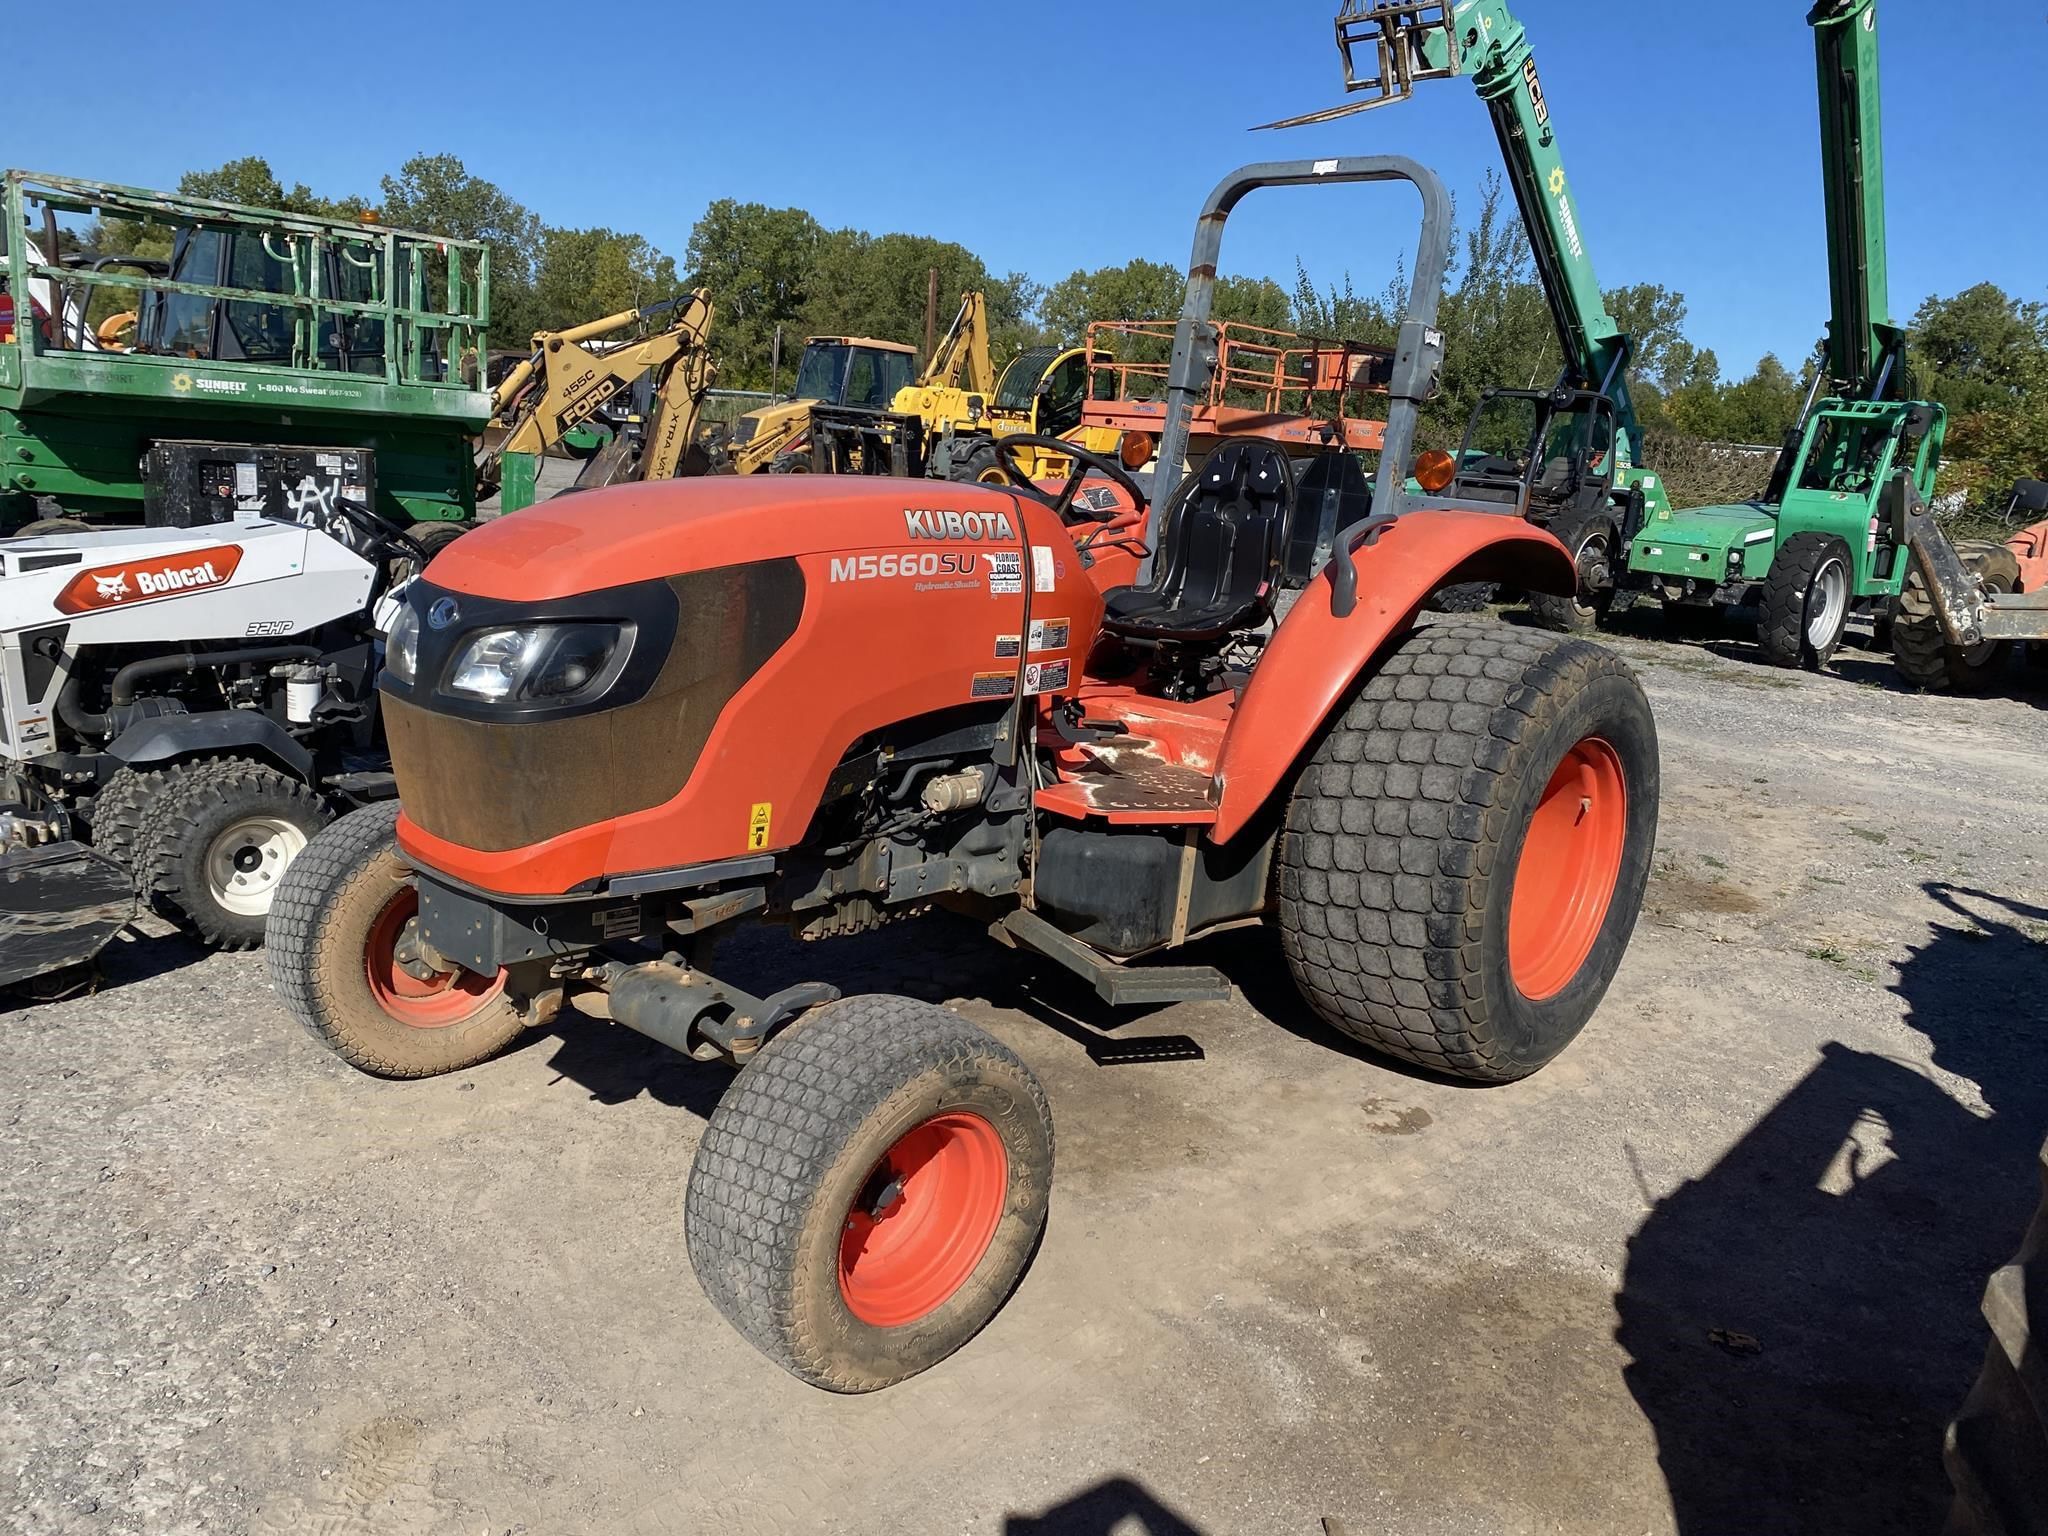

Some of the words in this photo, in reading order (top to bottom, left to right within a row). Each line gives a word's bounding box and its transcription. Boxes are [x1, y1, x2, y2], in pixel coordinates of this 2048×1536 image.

[1523, 58, 1548, 125] JCB
[1559, 194, 1582, 258] SUNBELT
[196, 379, 247, 392] SUNBELT
[257, 384, 284, 393] 1-800
[285, 385, 298, 394] No
[299, 386, 327, 396] Sweat
[562, 370, 595, 398] 455C
[562, 379, 615, 426] FORD
[904, 509, 1016, 541] KUBOTA
[830, 553, 976, 583] M5660SU
[995, 553, 1019, 563] FLORIDA
[996, 563, 1019, 573] COAST
[135, 561, 219, 595] Bobcat
[914, 581, 953, 593] Hydraulic
[953, 580, 981, 589] Shuttle
[246, 620, 294, 637] 32HP
